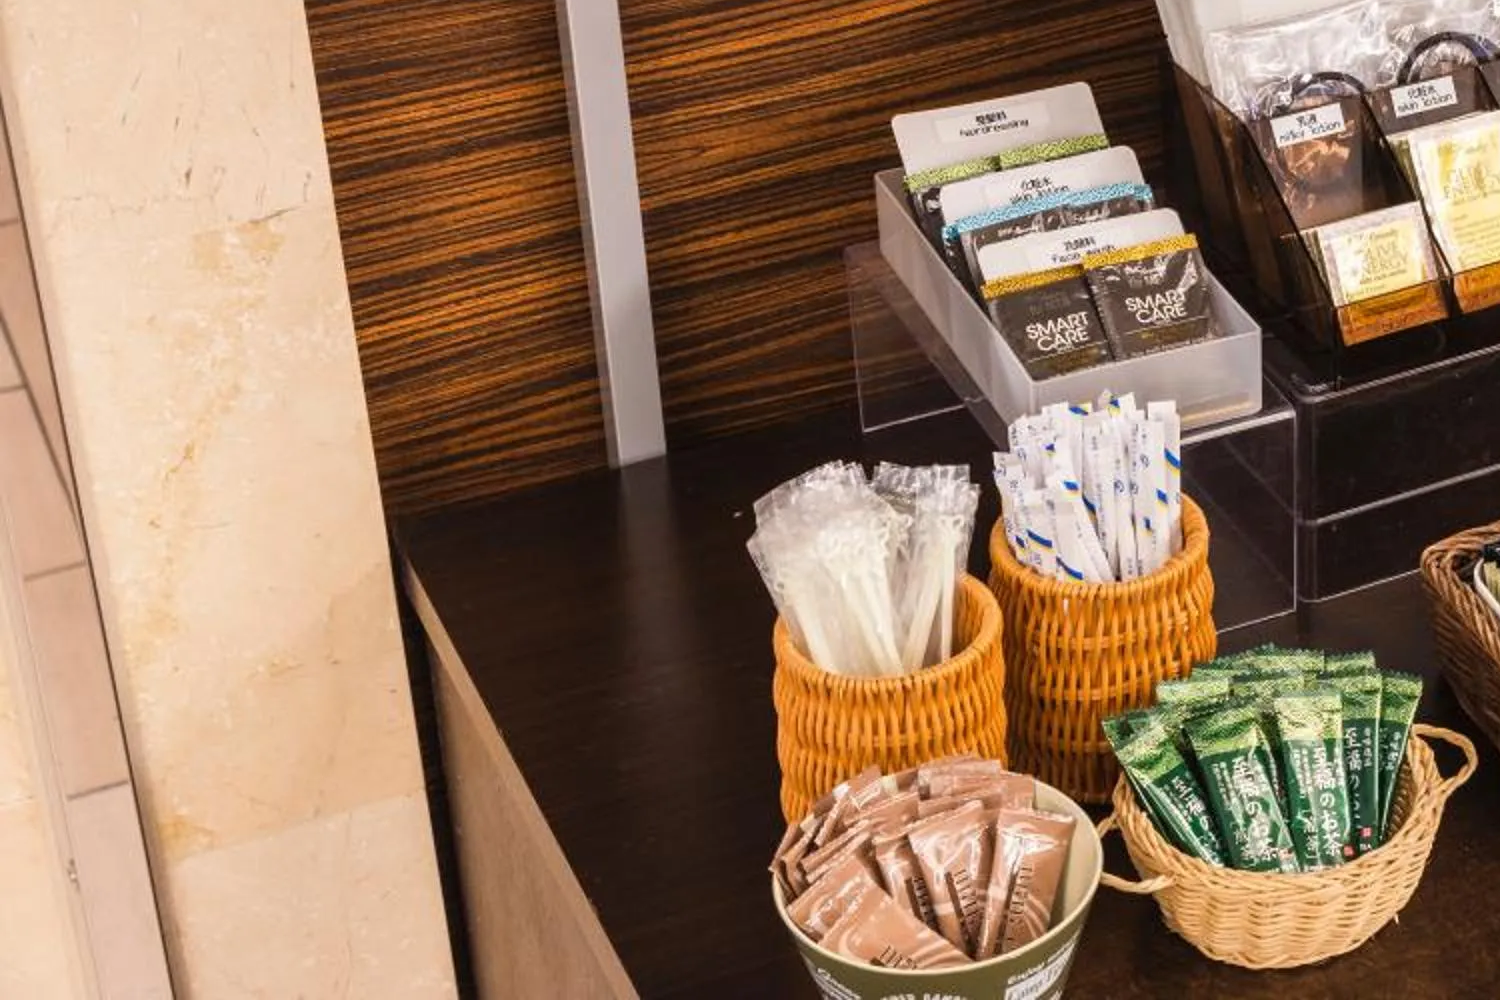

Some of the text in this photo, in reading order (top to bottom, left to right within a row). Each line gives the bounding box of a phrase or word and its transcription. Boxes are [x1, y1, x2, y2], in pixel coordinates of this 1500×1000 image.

[1125, 288, 1187, 312] SMART
[1025, 311, 1089, 340] SMART
[1136, 303, 1189, 324] CARE
[1036, 328, 1091, 352] CARE
